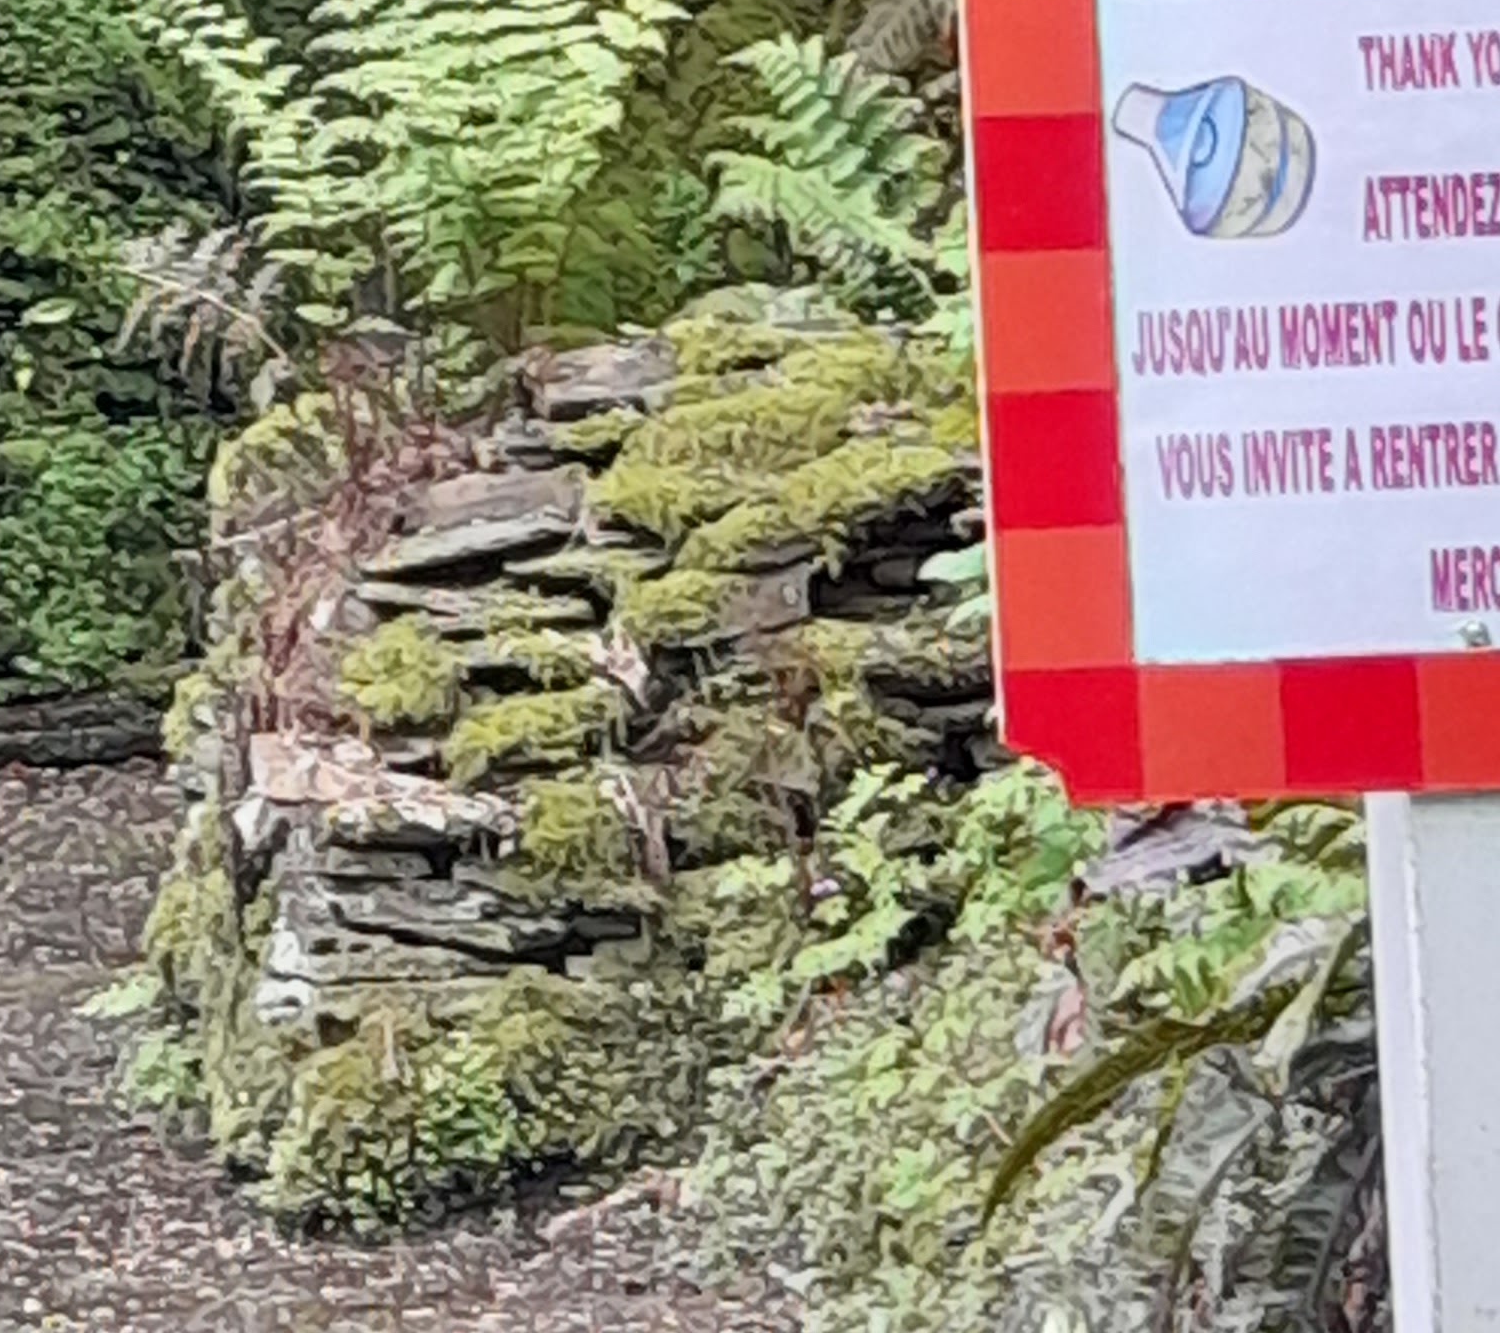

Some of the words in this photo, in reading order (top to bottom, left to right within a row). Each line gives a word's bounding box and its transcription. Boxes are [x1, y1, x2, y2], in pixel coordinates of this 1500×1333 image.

[1358, 31, 1461, 91] THANK
[1363, 172, 1500, 242] ATTENDEZ
[1131, 305, 1270, 376] JUSQU'AU
[1279, 300, 1397, 370] MOMENT
[1408, 299, 1446, 364] OU
[1455, 297, 1489, 362] LE
[1156, 432, 1235, 500] VOUS
[1242, 428, 1335, 497] INVITE
[1344, 427, 1363, 491] A
[1370, 421, 1500, 490] RENTRER
